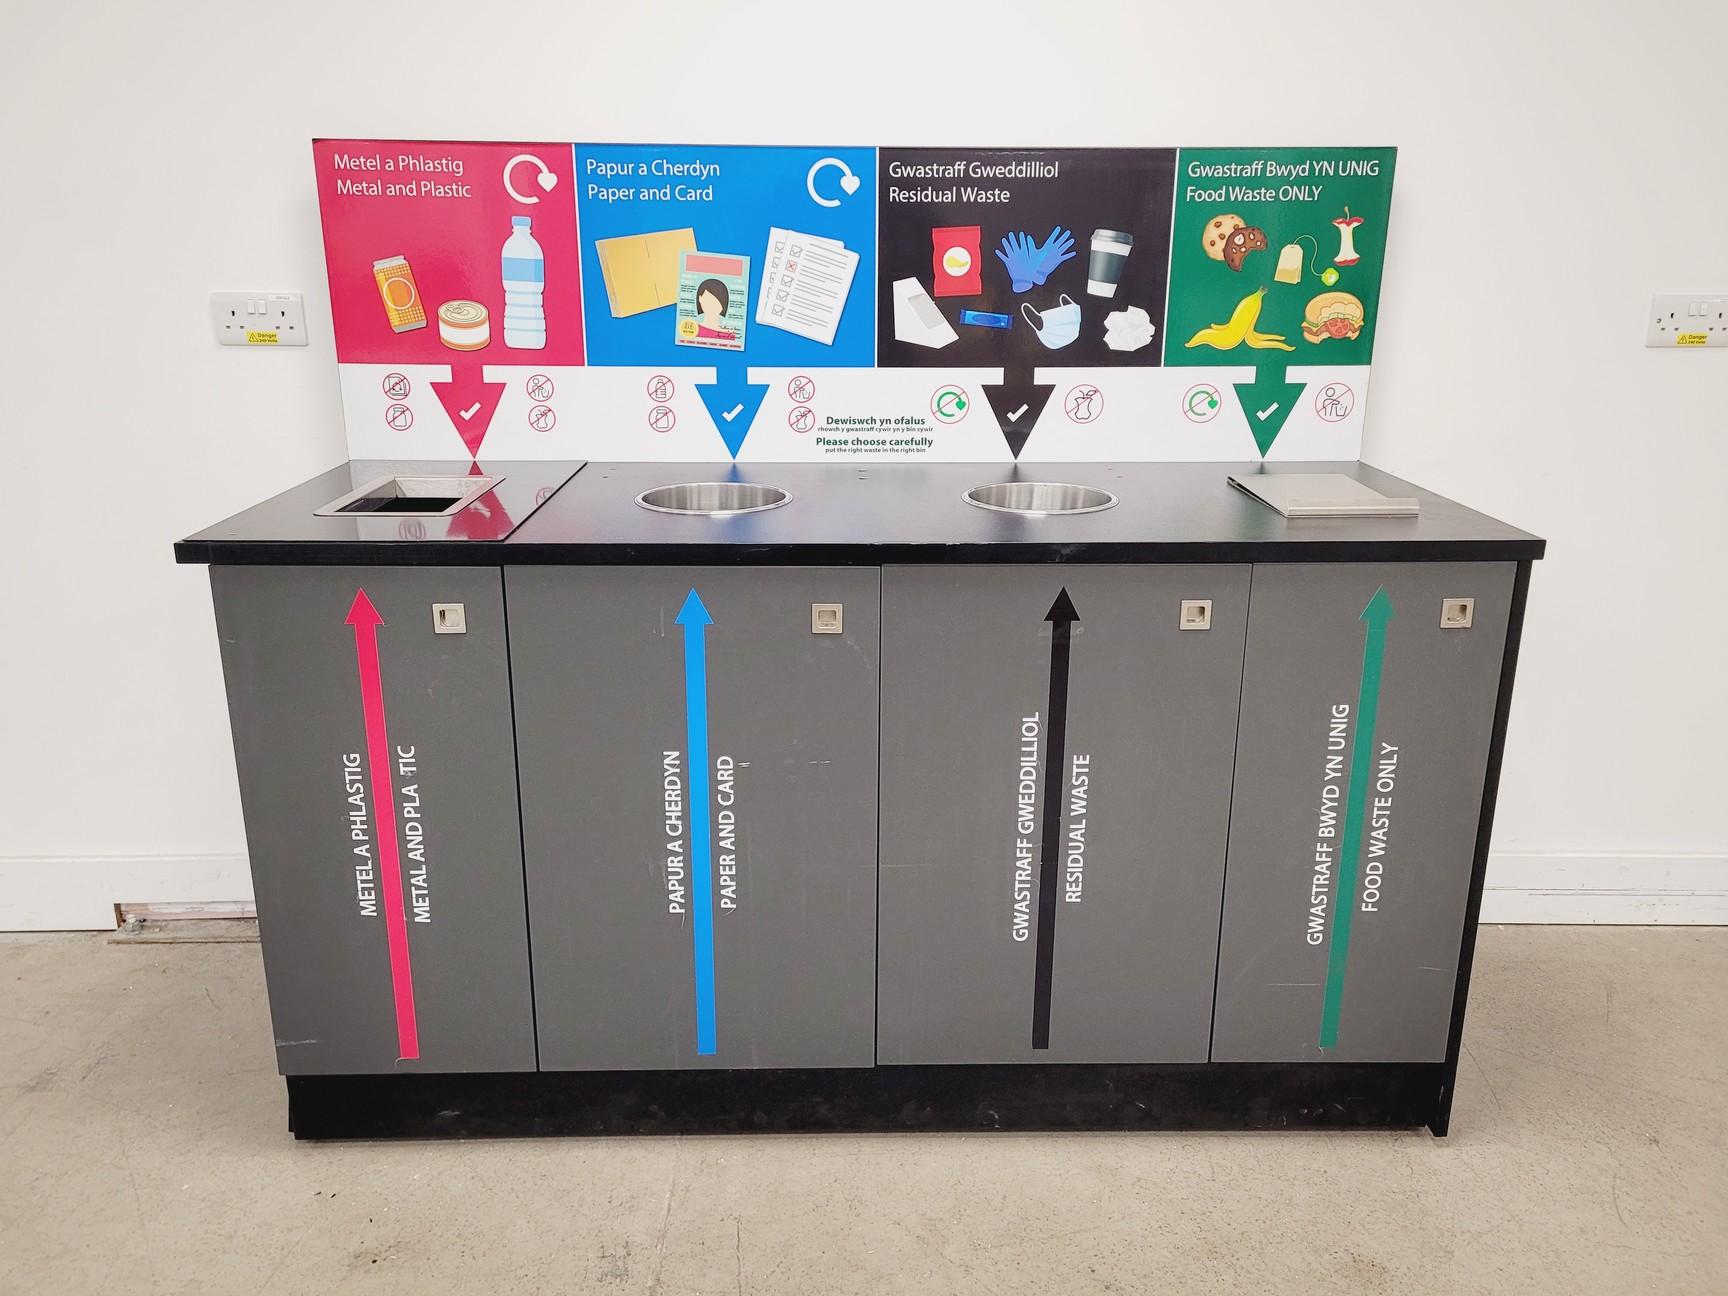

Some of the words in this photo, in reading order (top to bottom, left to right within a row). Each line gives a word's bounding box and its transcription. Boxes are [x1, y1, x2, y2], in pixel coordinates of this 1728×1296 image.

[334, 154, 381, 171] Metel
[385, 158, 395, 171] a
[398, 155, 464, 177] Phlastig
[337, 179, 382, 196] Metal
[386, 180, 417, 197] and
[420, 180, 472, 198] Plastic
[586, 159, 635, 179] Papur
[638, 163, 648, 176] a
[651, 159, 720, 180] Cherdyn
[889, 161, 967, 178] Gwastraff
[969, 161, 1059, 178] Gweddilliol
[1188, 160, 1264, 178] Gwastraff
[1266, 160, 1310, 180] Bwyd
[1312, 160, 1335, 176] YN
[1338, 160, 1380, 176] UNIG
[588, 184, 635, 204] Paper
[639, 184, 671, 201] and
[675, 184, 713, 201] Card
[889, 186, 957, 203] Residual
[961, 186, 1010, 203] Waste
[1186, 185, 1226, 202] Food
[1229, 186, 1276, 202] Waste
[1278, 185, 1323, 201] ONLY
[816, 437, 849, 446] Please
[851, 437, 887, 446] choose
[889, 437, 934, 448] carefully
[826, 416, 877, 425] Dewiswch
[879, 419, 892, 427] yn
[894, 416, 926, 425] ofalus
[1328, 704, 1350, 750] UNIG
[397, 745, 421, 818] PLATIC
[716, 755, 735, 806] CARD
[1017, 711, 1039, 835] GWEDDILLIOL
[1070, 754, 1090, 817] WASTE
[1324, 755, 1344, 781] YN
[1376, 742, 1399, 794] ONLY
[343, 753, 369, 841] PHLASTIG
[663, 751, 682, 837] CHERDYN
[1318, 784, 1340, 838] BWYD
[353, 844, 371, 858] A
[405, 822, 425, 862] AND
[666, 840, 683, 853] A
[718, 811, 735, 851] AND
[1368, 797, 1392, 858] WASTE
[667, 856, 685, 914] PAPUR
[719, 854, 737, 909] PAPER
[1065, 818, 1086, 903] RESIDUAL
[355, 859, 378, 917] METEL
[409, 864, 431, 923] METAL
[1012, 838, 1033, 942] GWASTRAFF
[1306, 842, 1333, 946] GWASTRAFF
[1361, 861, 1383, 912] FOOD
